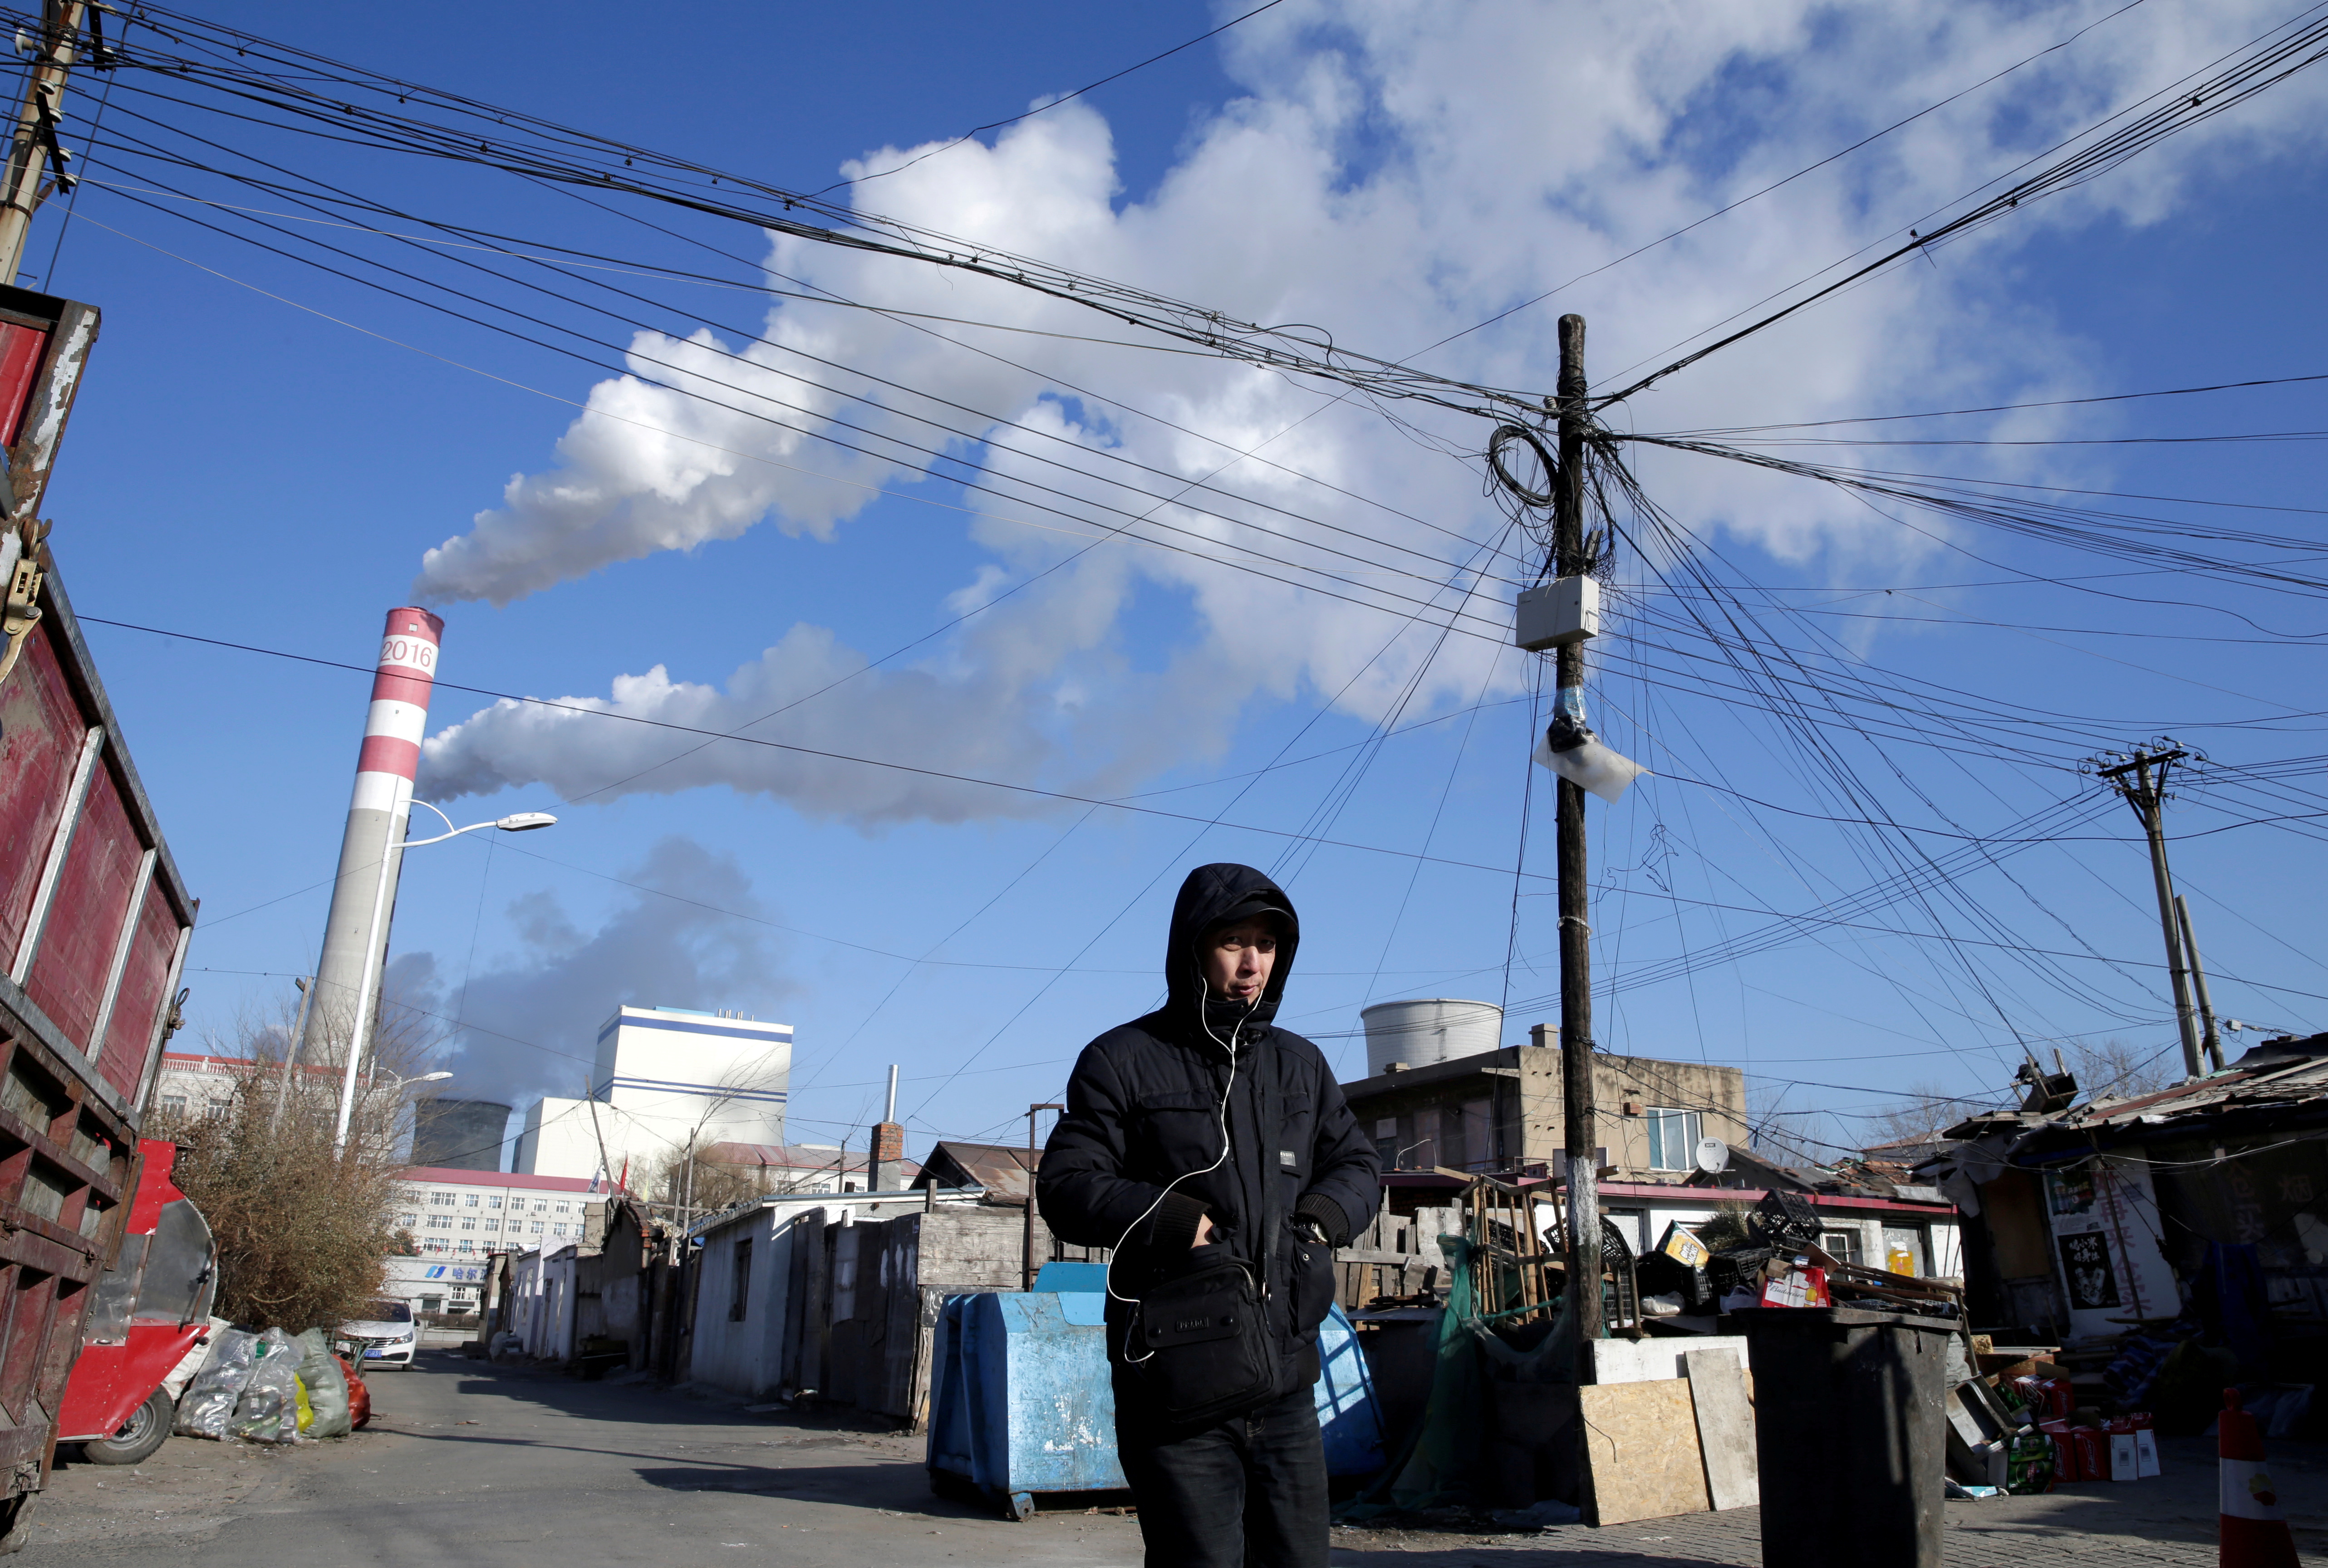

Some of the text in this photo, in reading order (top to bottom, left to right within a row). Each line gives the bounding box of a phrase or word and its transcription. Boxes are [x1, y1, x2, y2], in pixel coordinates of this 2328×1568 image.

[380, 641, 432, 667] 2016
[1768, 1284, 1804, 1298] Budweiser
[1180, 1319, 1204, 1329] PRADA
